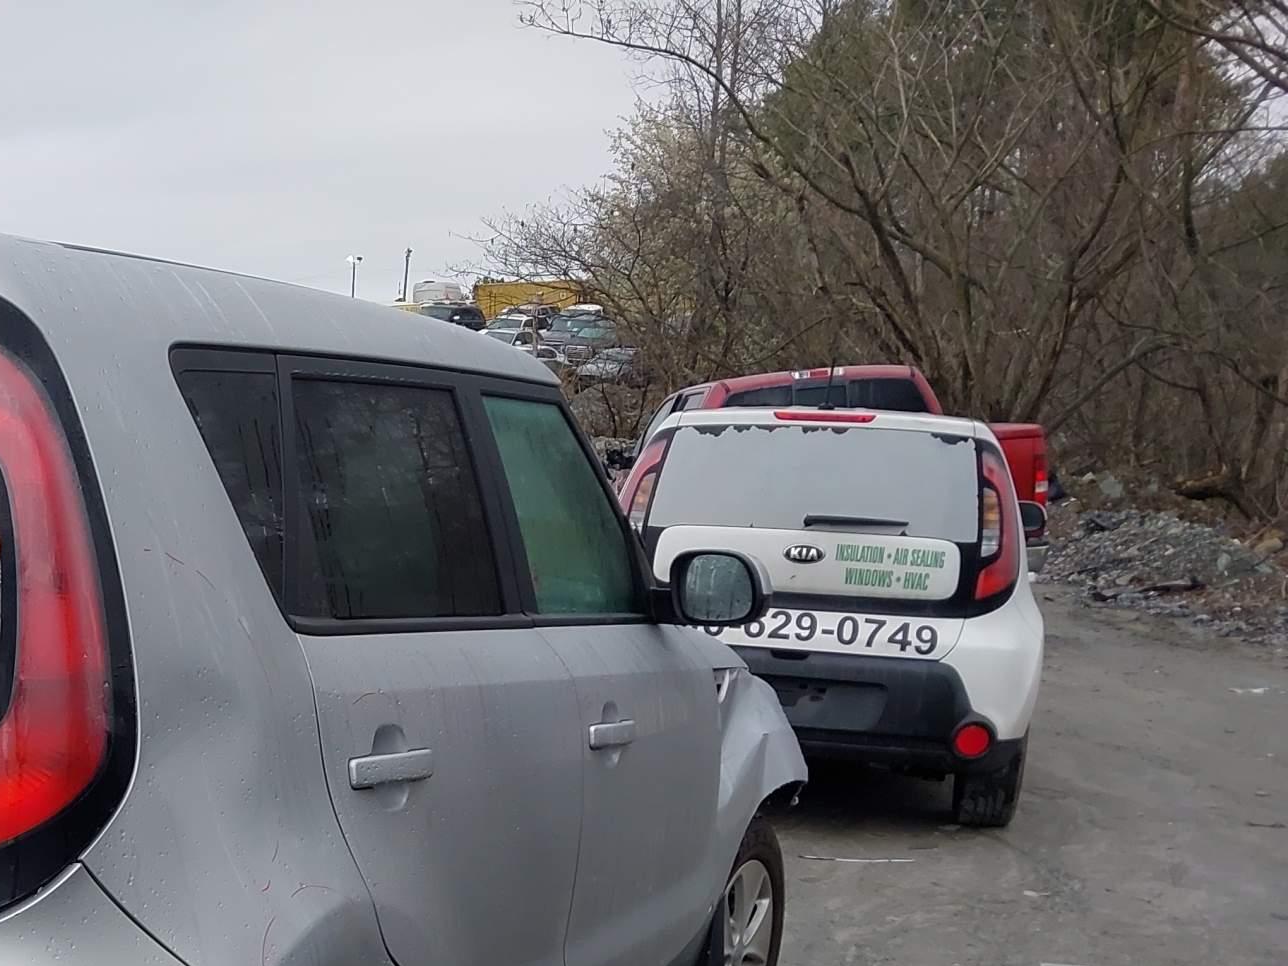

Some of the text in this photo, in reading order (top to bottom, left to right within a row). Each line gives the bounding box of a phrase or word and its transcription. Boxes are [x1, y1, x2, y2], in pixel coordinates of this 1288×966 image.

[835, 543, 947, 569] INSULATION AIR SEALING
[844, 567, 930, 591] WINDOWS HVAC
